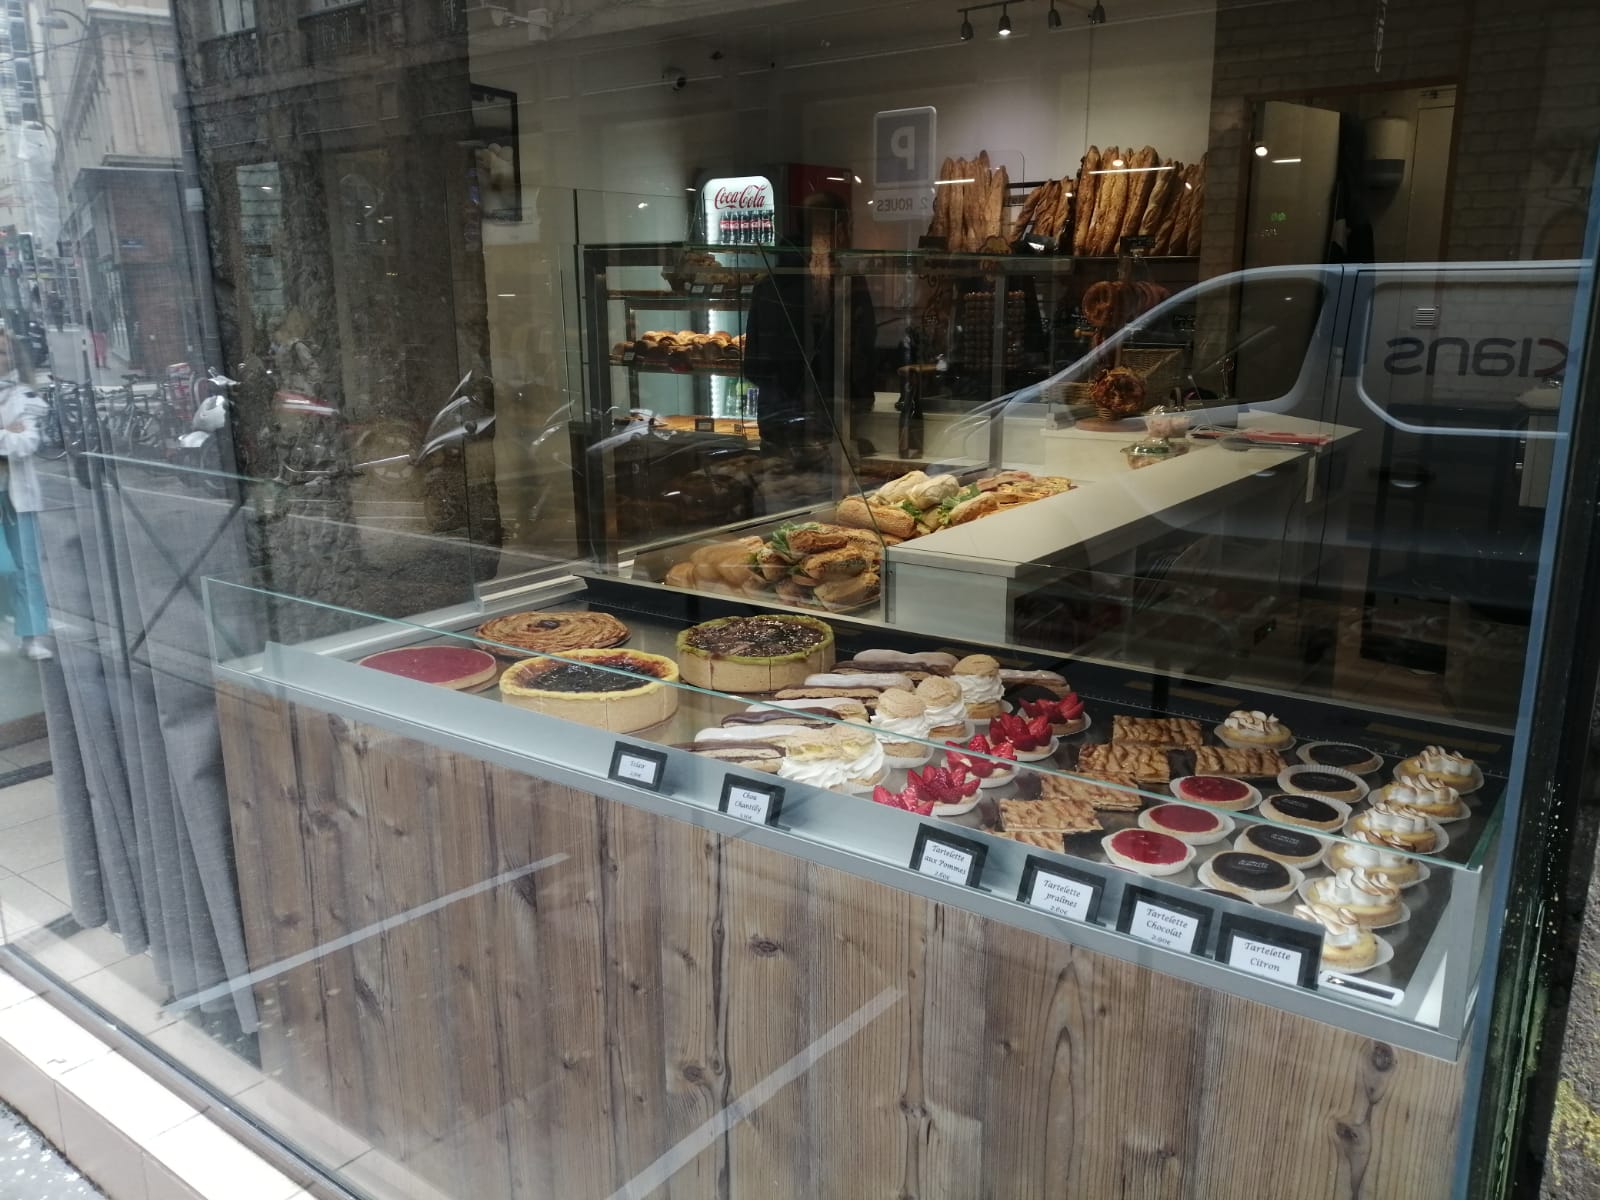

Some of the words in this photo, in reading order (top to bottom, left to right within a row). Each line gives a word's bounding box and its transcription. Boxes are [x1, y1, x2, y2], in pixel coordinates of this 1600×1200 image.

[931, 843, 966, 862] Tartelette
[938, 858, 967, 876] Pommes
[1043, 878, 1081, 898] Tartelette
[1044, 891, 1078, 908] pralines
[1146, 907, 1189, 929] Tartelette
[1146, 919, 1183, 939] Chocolat
[1244, 941, 1292, 961] Tartelette
[1250, 956, 1281, 972] Citron
